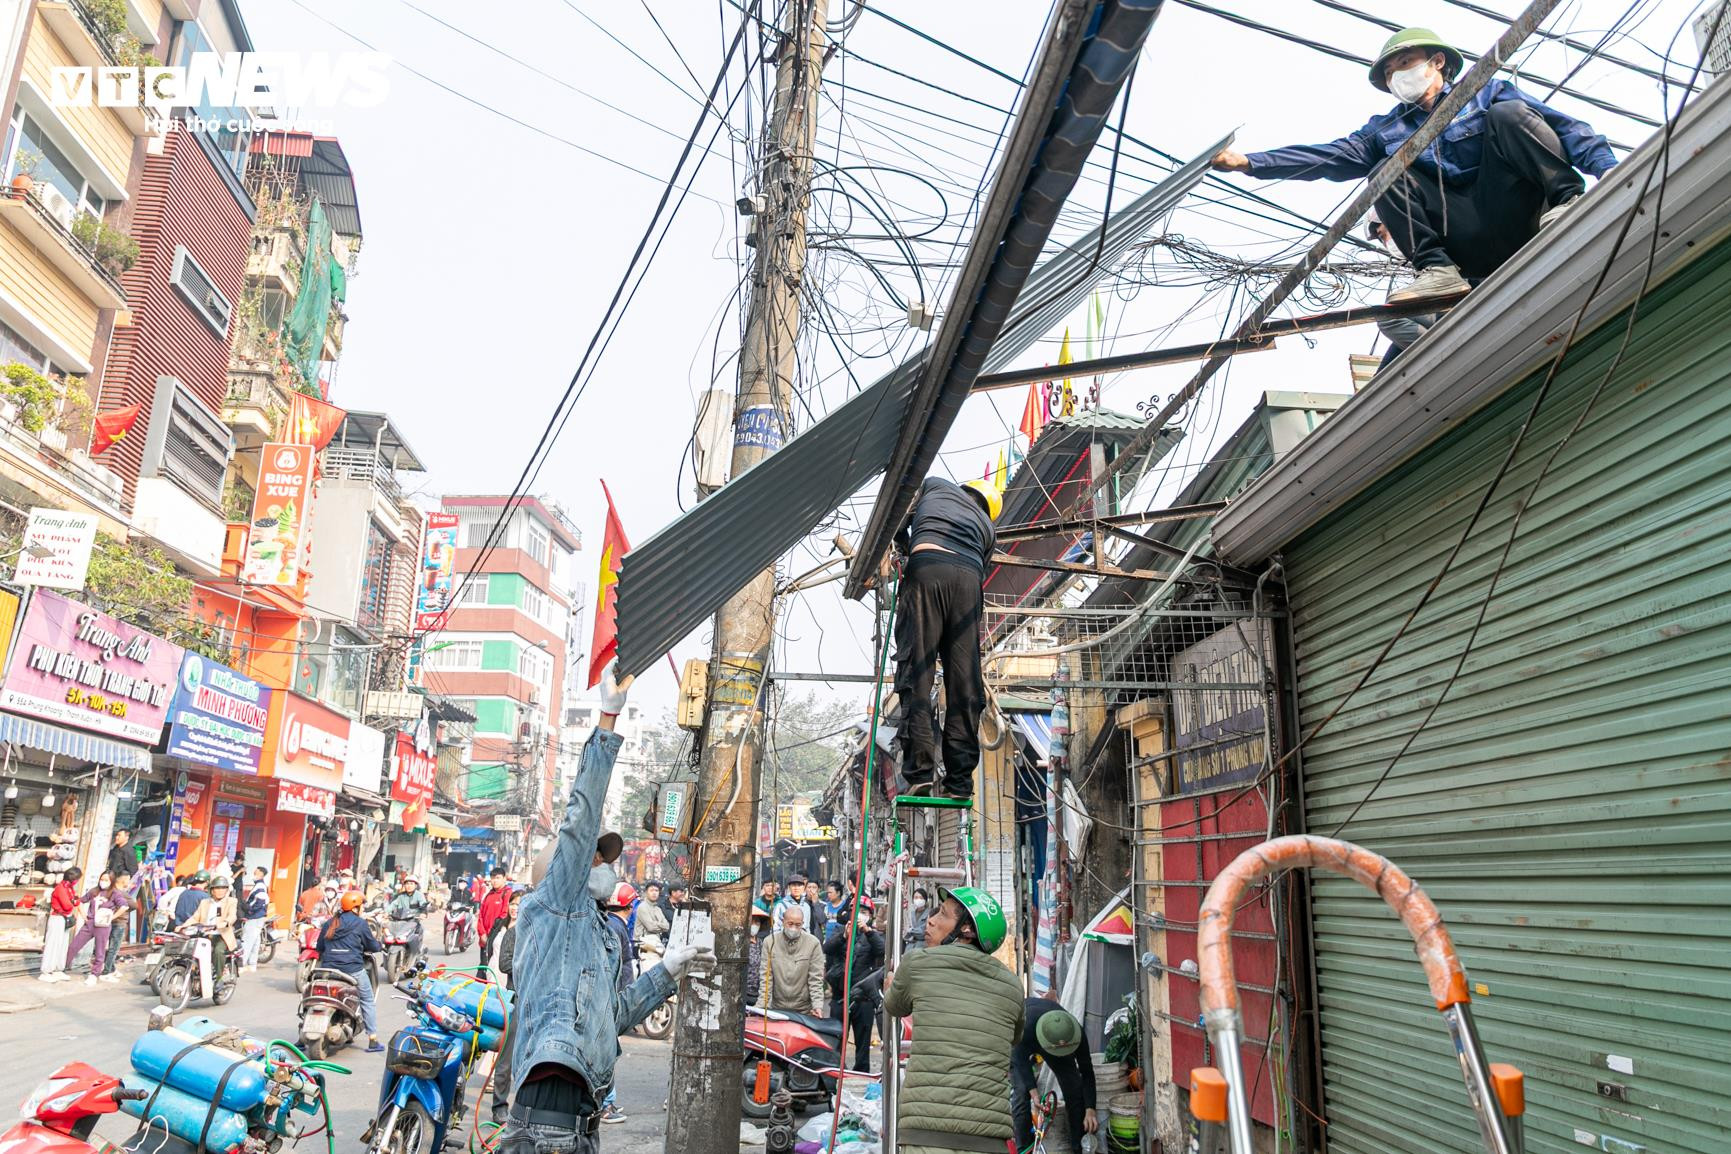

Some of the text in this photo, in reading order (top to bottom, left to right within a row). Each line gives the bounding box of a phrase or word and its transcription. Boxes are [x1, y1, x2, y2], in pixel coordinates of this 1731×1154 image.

[264, 473, 303, 485] BING
[266, 486, 299, 497] XUE
[33, 515, 64, 529] Trang
[80, 613, 119, 661] Trang
[31, 645, 57, 677] PHỤ
[102, 668, 132, 697] TRANG
[196, 687, 267, 730] MINH PHƯƠNG
[408, 753, 436, 789] MIXUE
